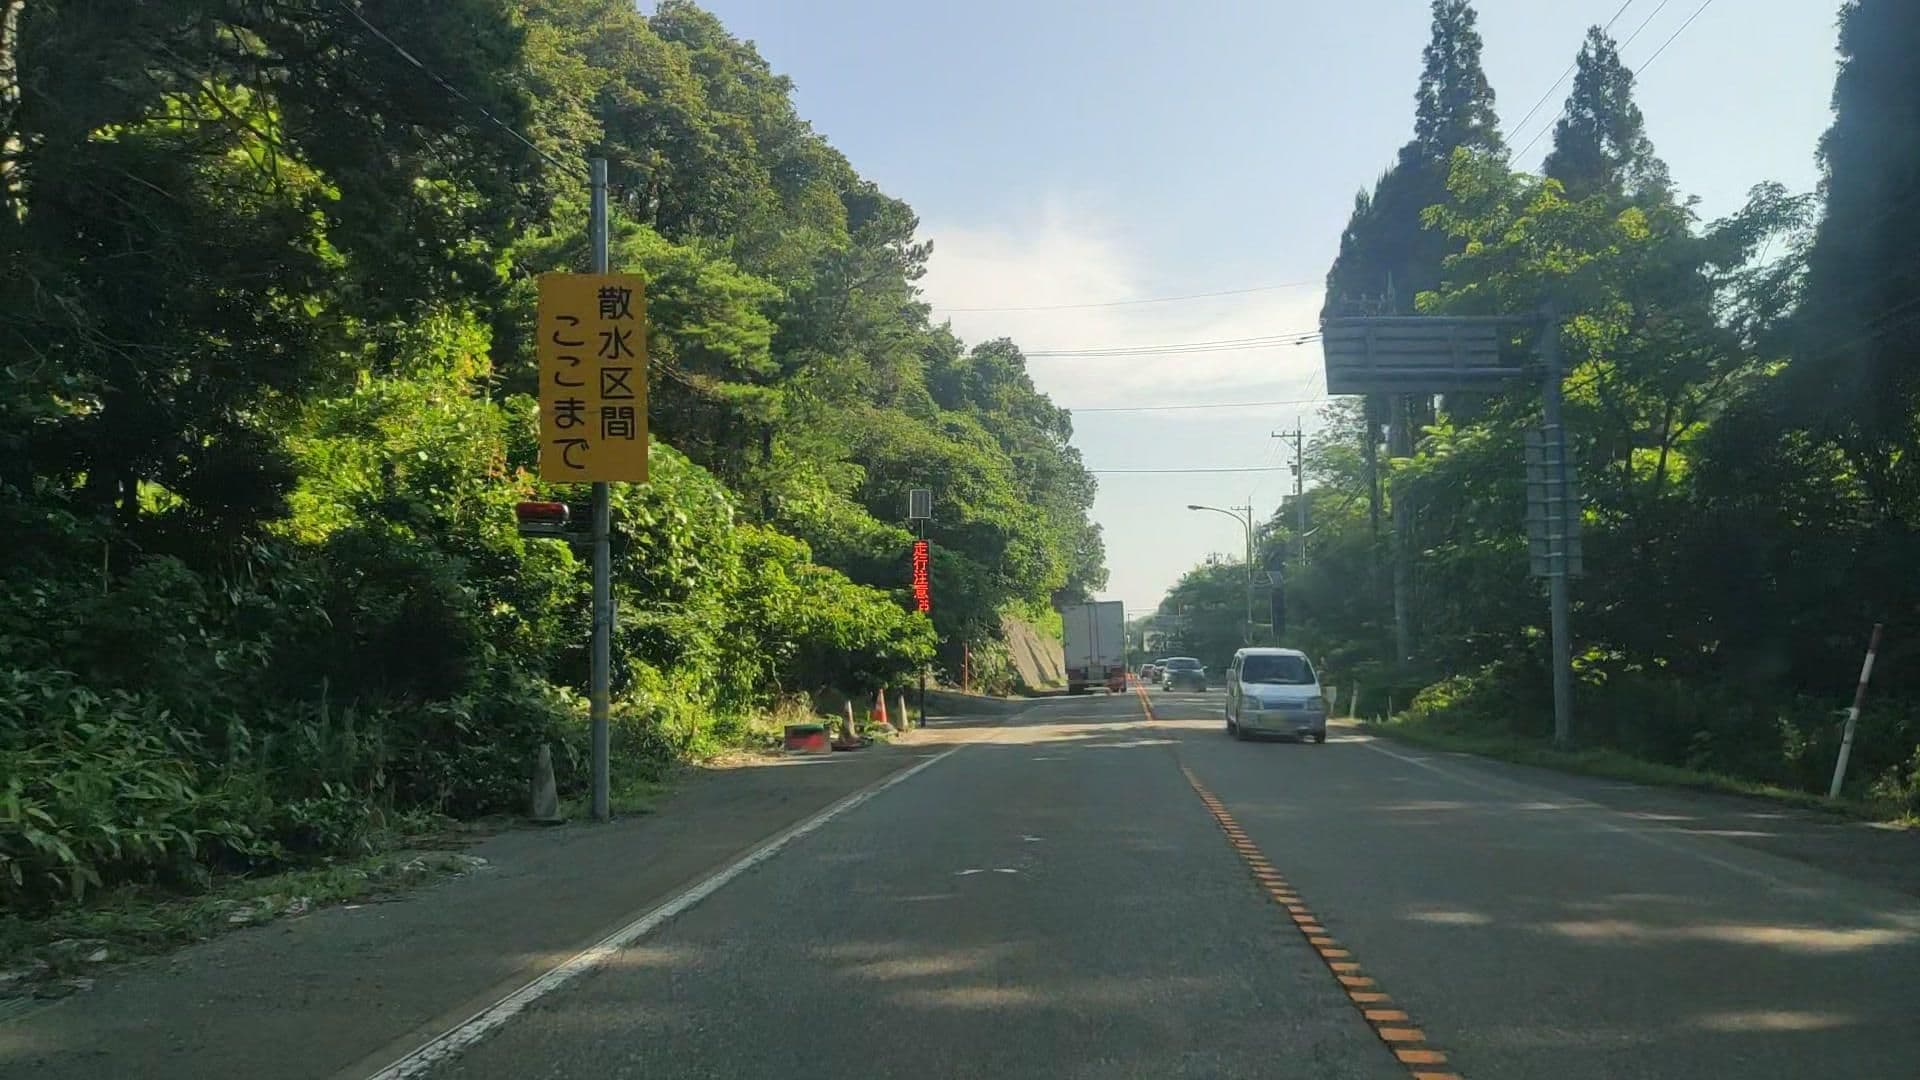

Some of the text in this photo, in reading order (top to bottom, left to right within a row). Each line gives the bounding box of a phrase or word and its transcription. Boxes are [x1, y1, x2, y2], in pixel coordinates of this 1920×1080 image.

[552, 315, 590, 470] ここまで
[597, 285, 635, 441] 散水区間
